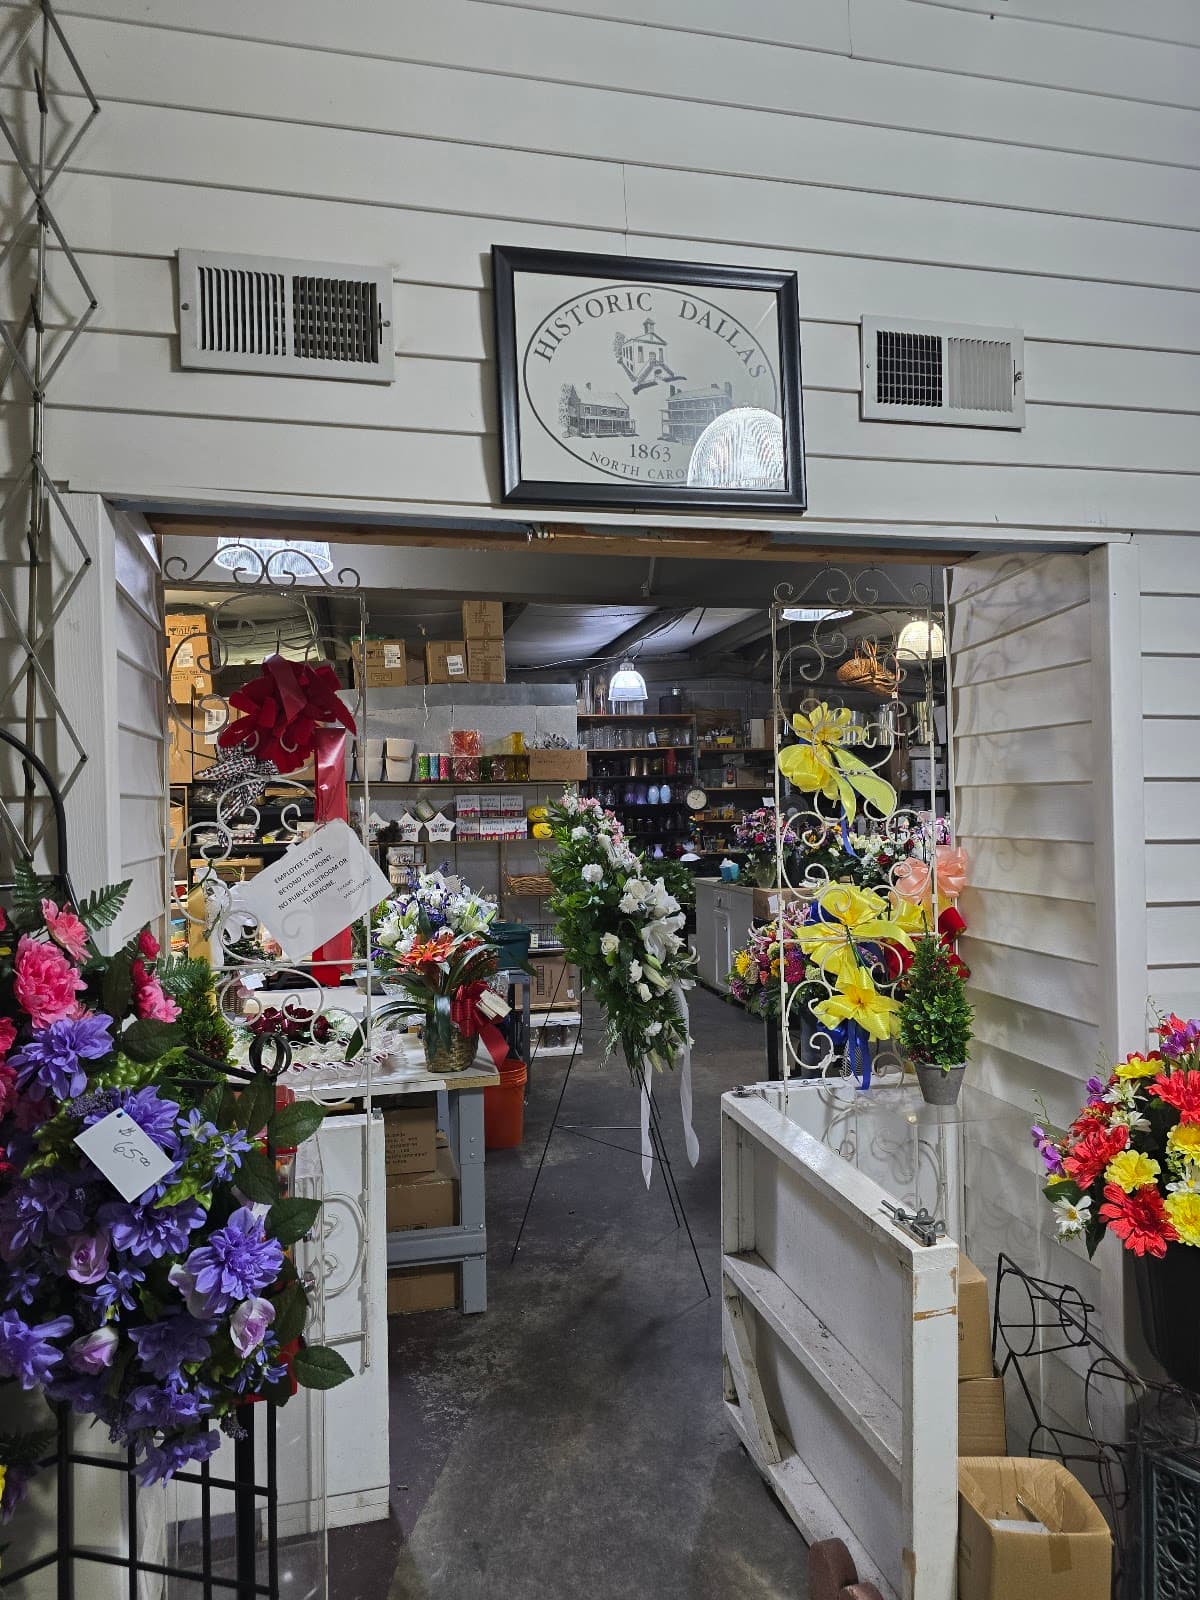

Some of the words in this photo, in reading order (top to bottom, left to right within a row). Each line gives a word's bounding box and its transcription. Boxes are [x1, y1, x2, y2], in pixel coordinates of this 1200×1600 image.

[533, 292, 653, 363] HISTORIC
[678, 299, 767, 378] DALLAS
[589, 451, 640, 477] NORTH
[629, 443, 672, 462] 1863
[274, 857, 309, 884] EMPLOYEE'S
[308, 847, 323, 860] ONLY
[278, 876, 302, 896] BEYOND
[301, 867, 315, 879] THIS
[278, 900, 289, 911] NO
[288, 887, 308, 904] PUBLIC
[308, 864, 339, 888] RESTROOM
[338, 857, 349, 867] OR
